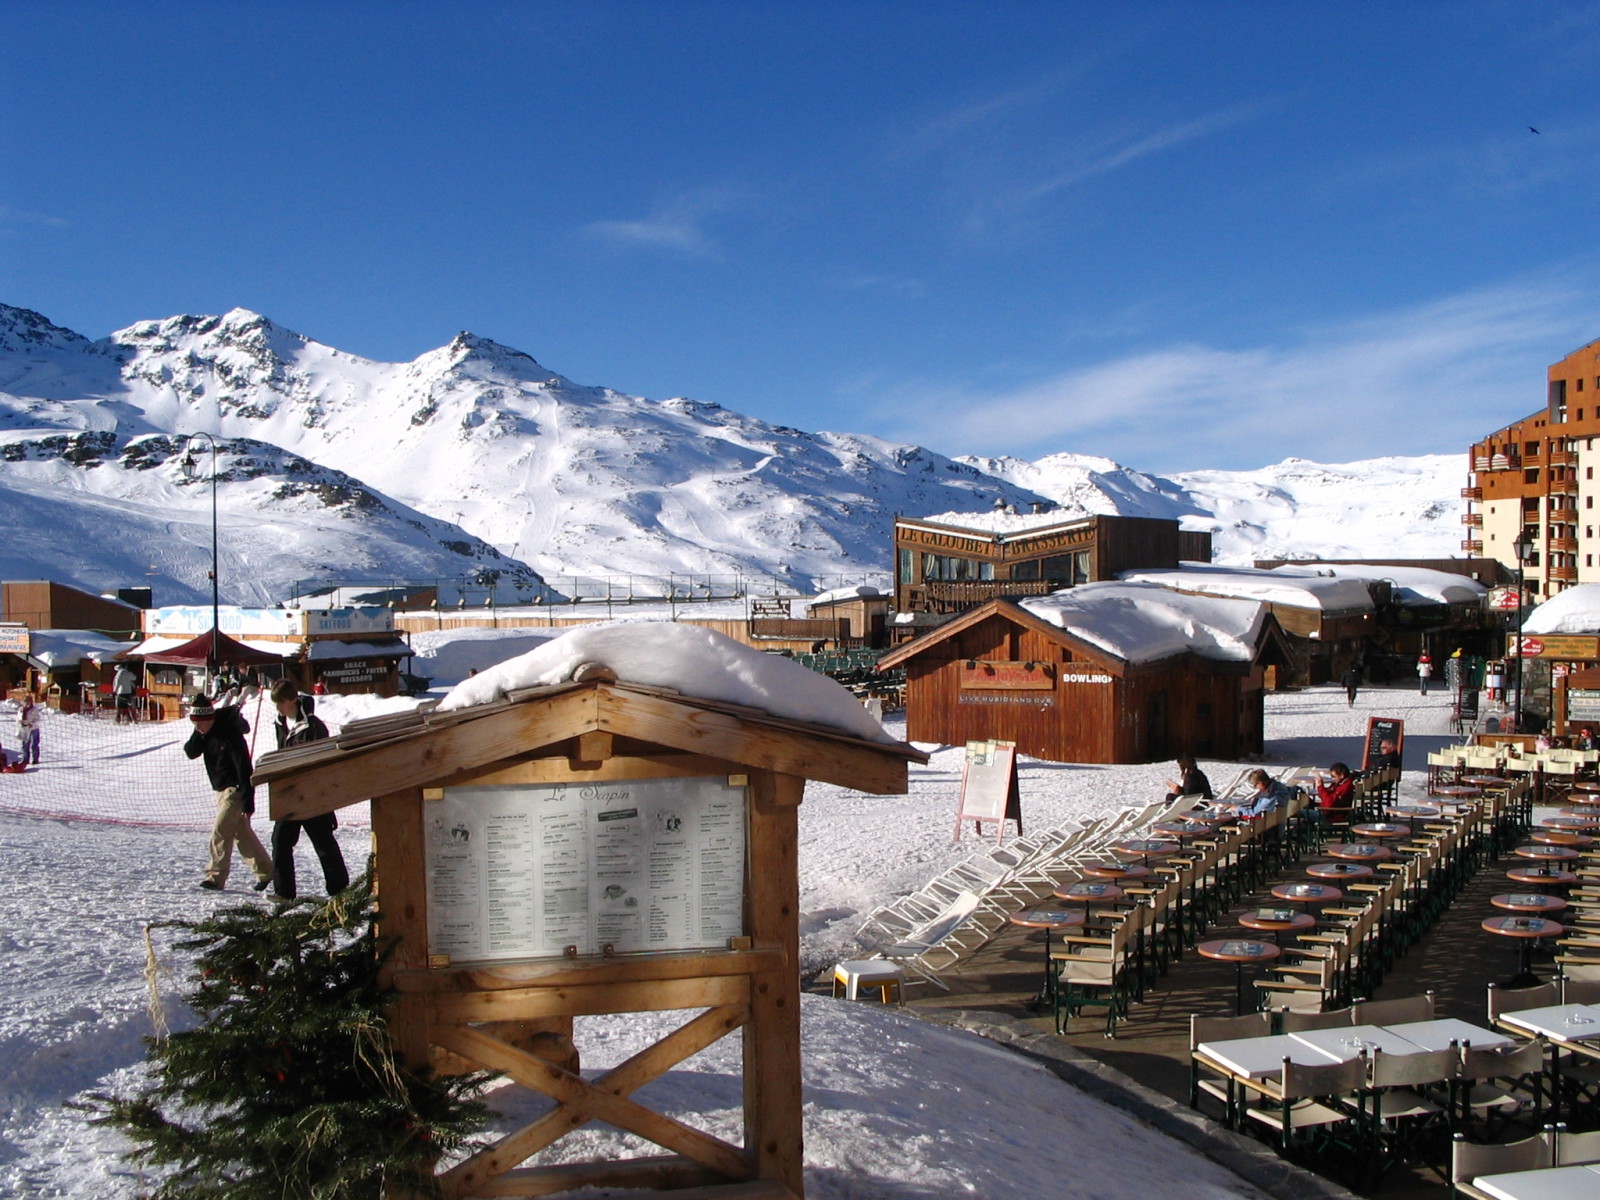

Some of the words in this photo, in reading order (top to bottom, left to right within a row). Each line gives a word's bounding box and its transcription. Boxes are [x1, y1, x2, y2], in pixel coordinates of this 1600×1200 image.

[900, 527, 917, 542] LE
[921, 531, 991, 555] GALOUBET
[1010, 529, 1095, 555] BRASSERIE
[320, 619, 332, 630] SKI
[333, 619, 352, 629] FOOD
[340, 675, 373, 683] BOISSONS
[1063, 674, 1108, 684] BOWLING
[543, 783, 568, 802] Le
